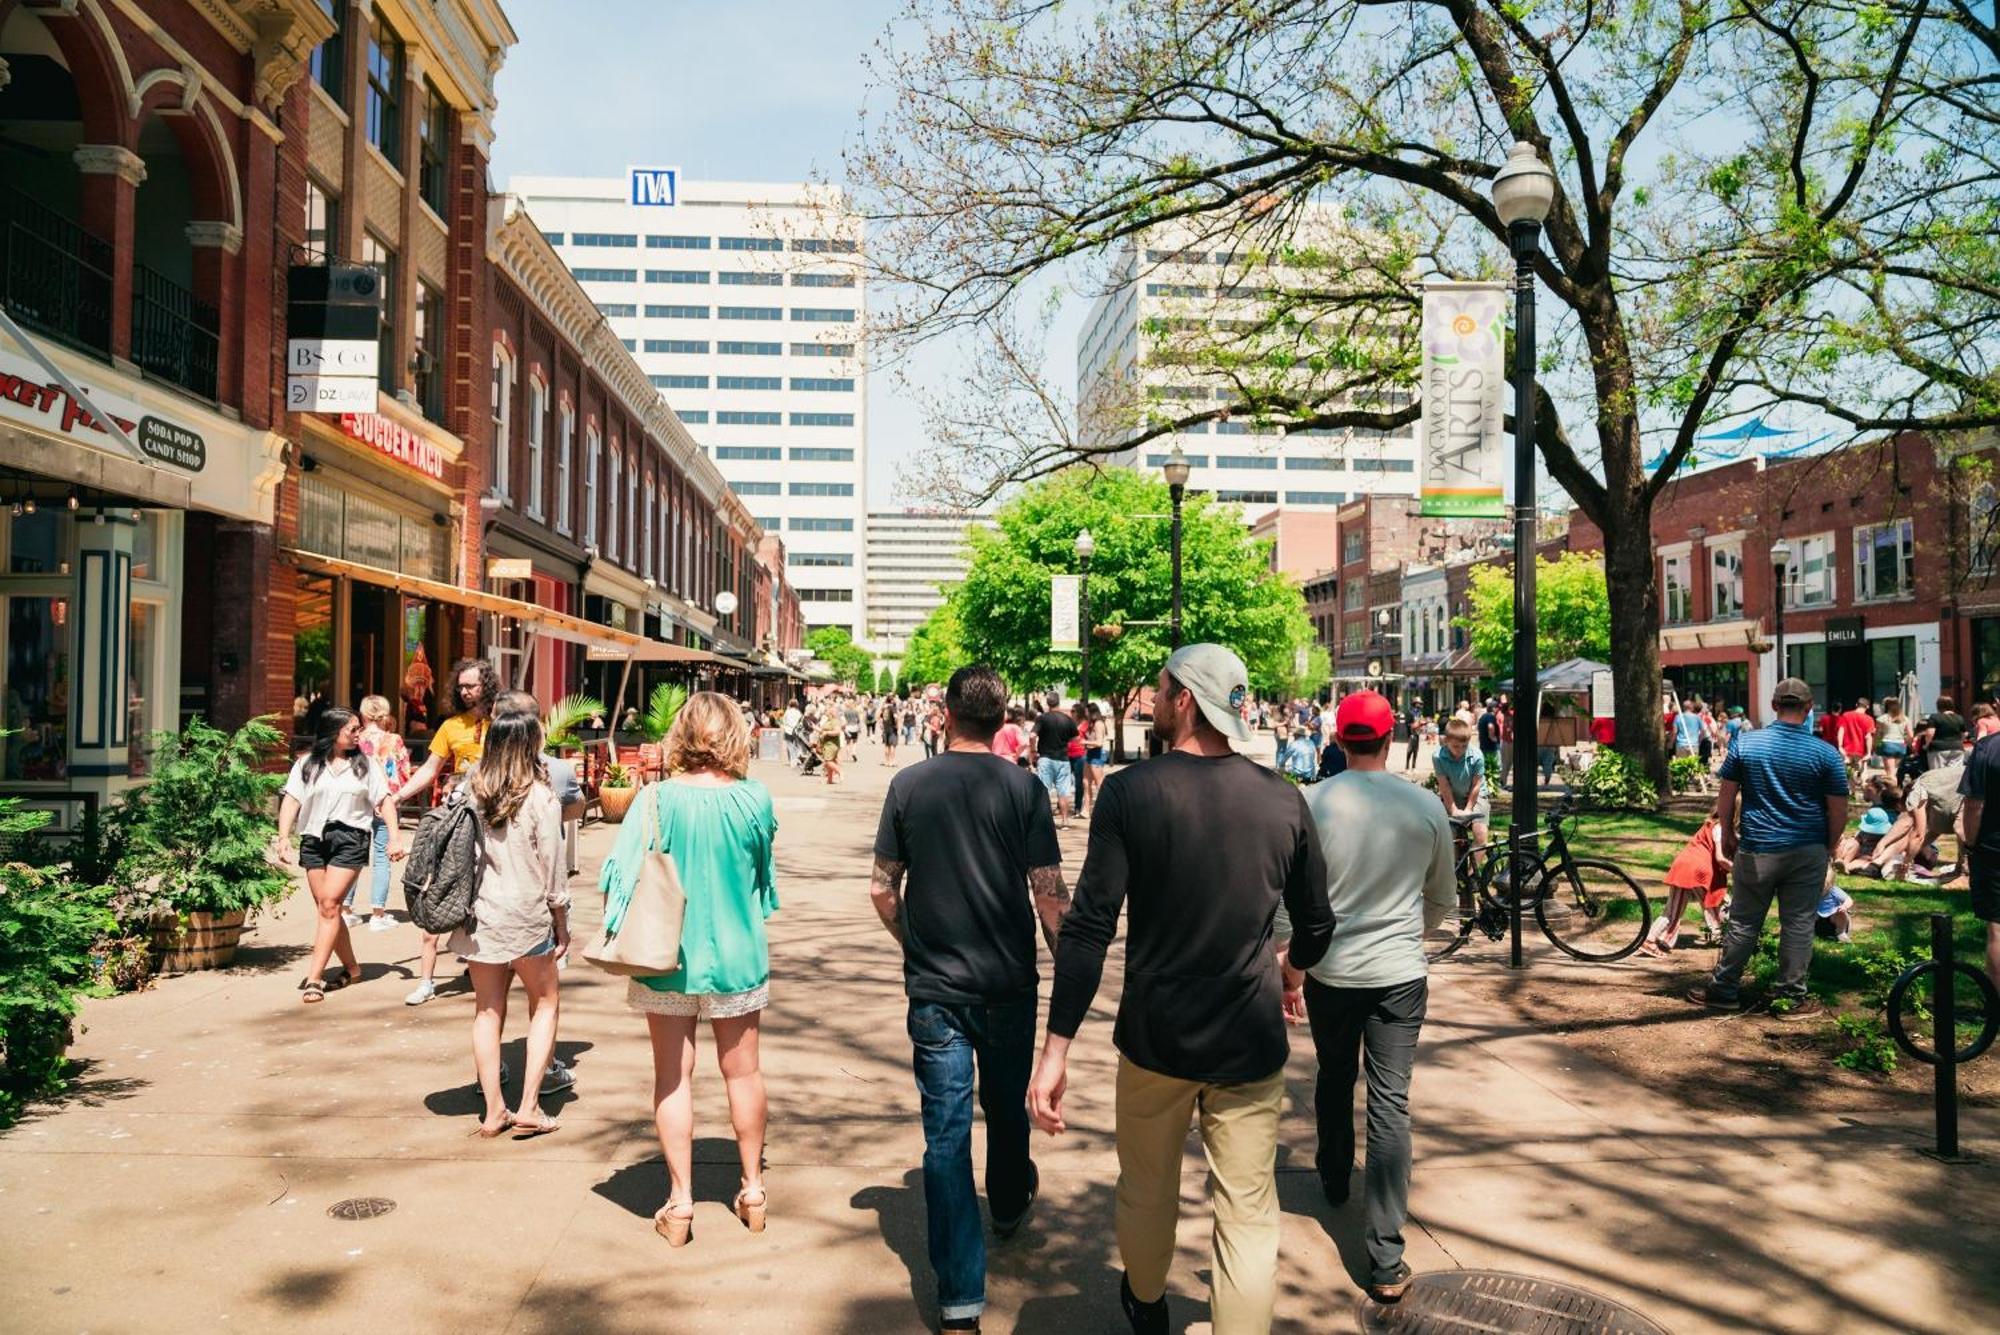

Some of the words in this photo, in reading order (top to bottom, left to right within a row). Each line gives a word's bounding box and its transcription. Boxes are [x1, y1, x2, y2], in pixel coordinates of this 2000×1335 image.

[634, 172, 673, 204] TVA
[319, 389, 337, 401] DZ
[147, 421, 173, 441] SODA
[174, 431, 193, 447] POP
[194, 439, 200, 451] &
[1428, 366, 1448, 481] DOGWOOD
[1437, 368, 1484, 480] ARTS
[145, 438, 175, 459] CANDY
[176, 448, 201, 467] SHOP
[410, 434, 442, 478] TACO
[1828, 630, 1857, 641] EMILIA
